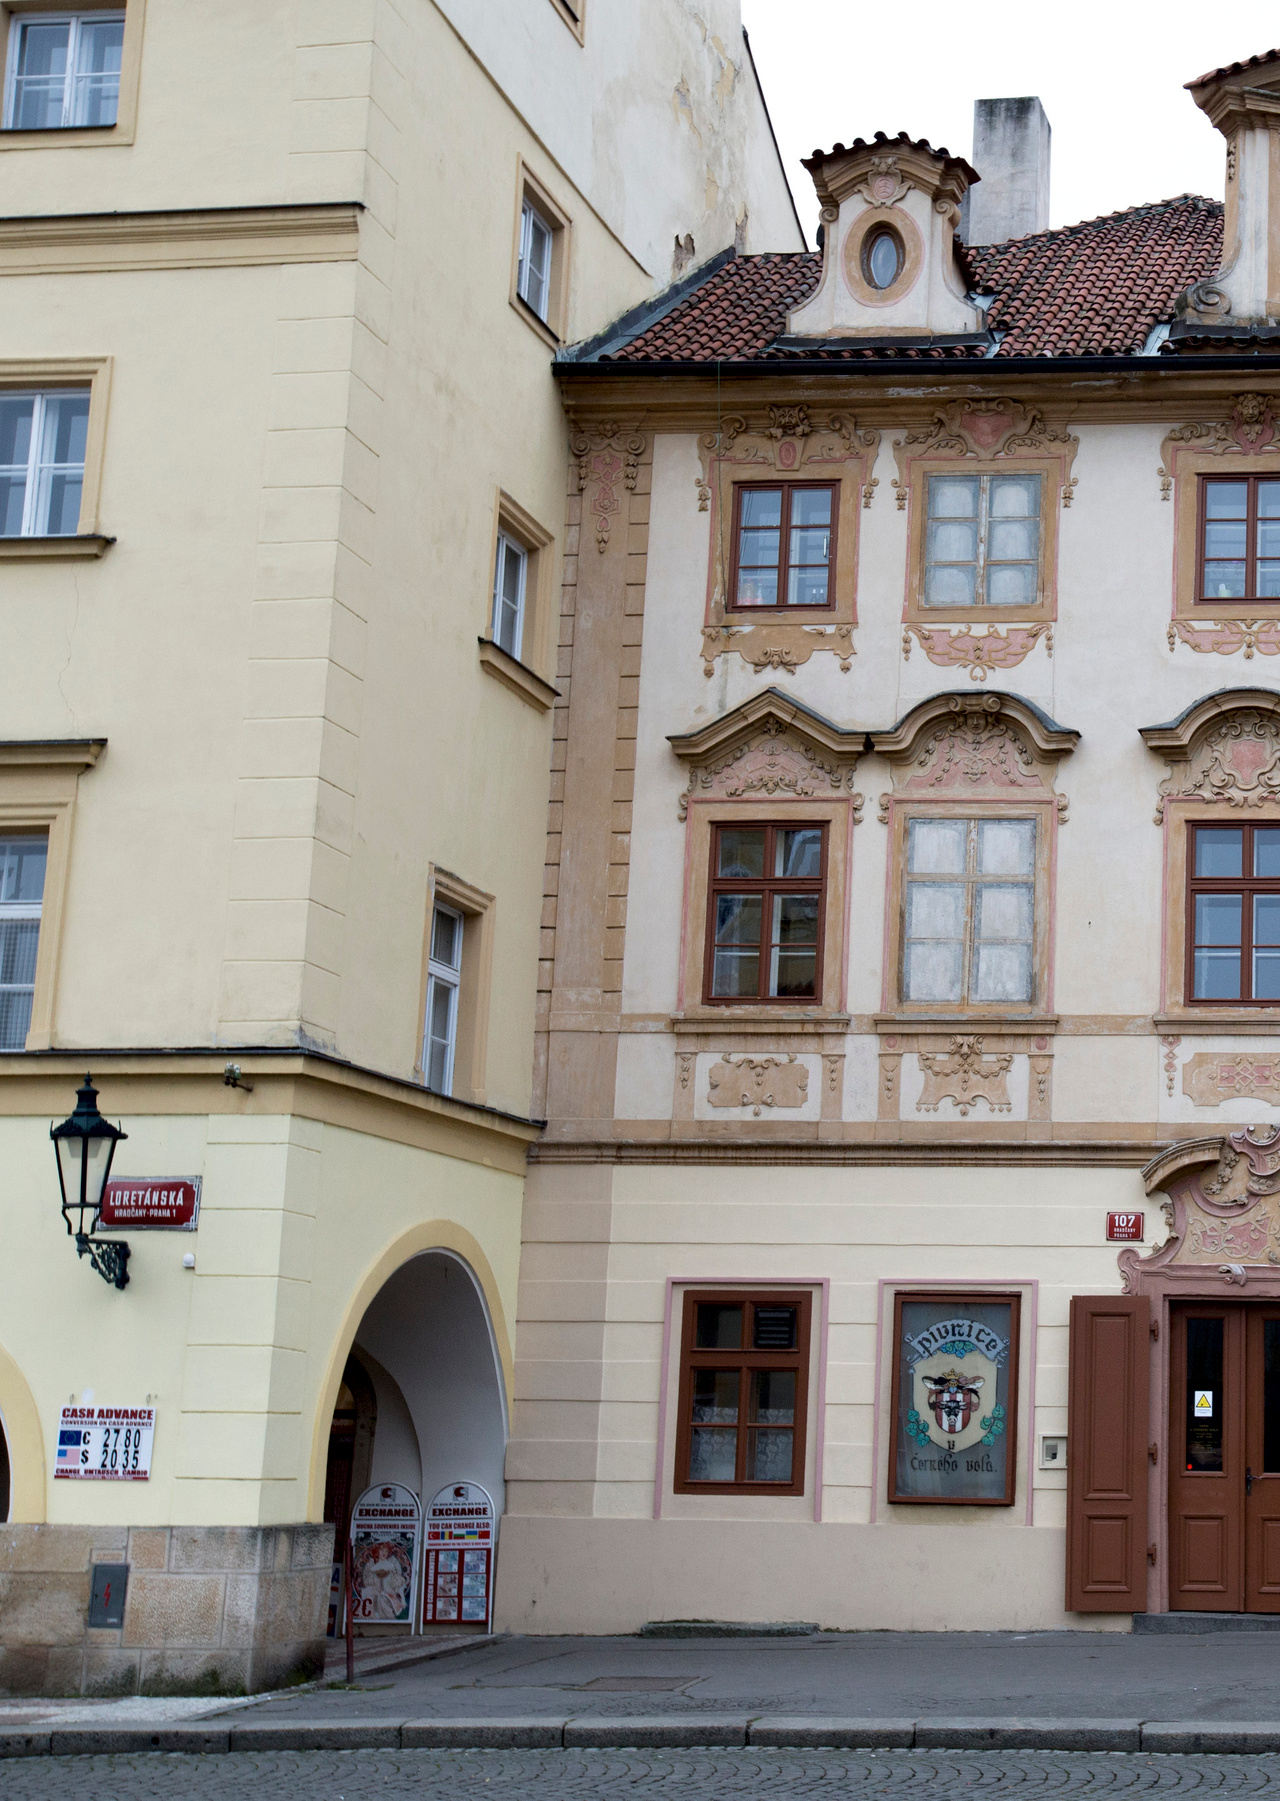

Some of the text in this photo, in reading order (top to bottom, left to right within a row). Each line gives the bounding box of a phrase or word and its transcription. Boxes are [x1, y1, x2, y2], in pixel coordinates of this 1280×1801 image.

[110, 1188, 184, 1206] LORETÁNSKÁ
[172, 1208, 176, 1218] 1
[1114, 1215, 1136, 1227] 107
[62, 1408, 154, 1420] CASH ADVANCE
[81, 1449, 89, 1464] $
[359, 1508, 414, 1517] EXCHANGE
[432, 1508, 488, 1516] EXCHANGE
